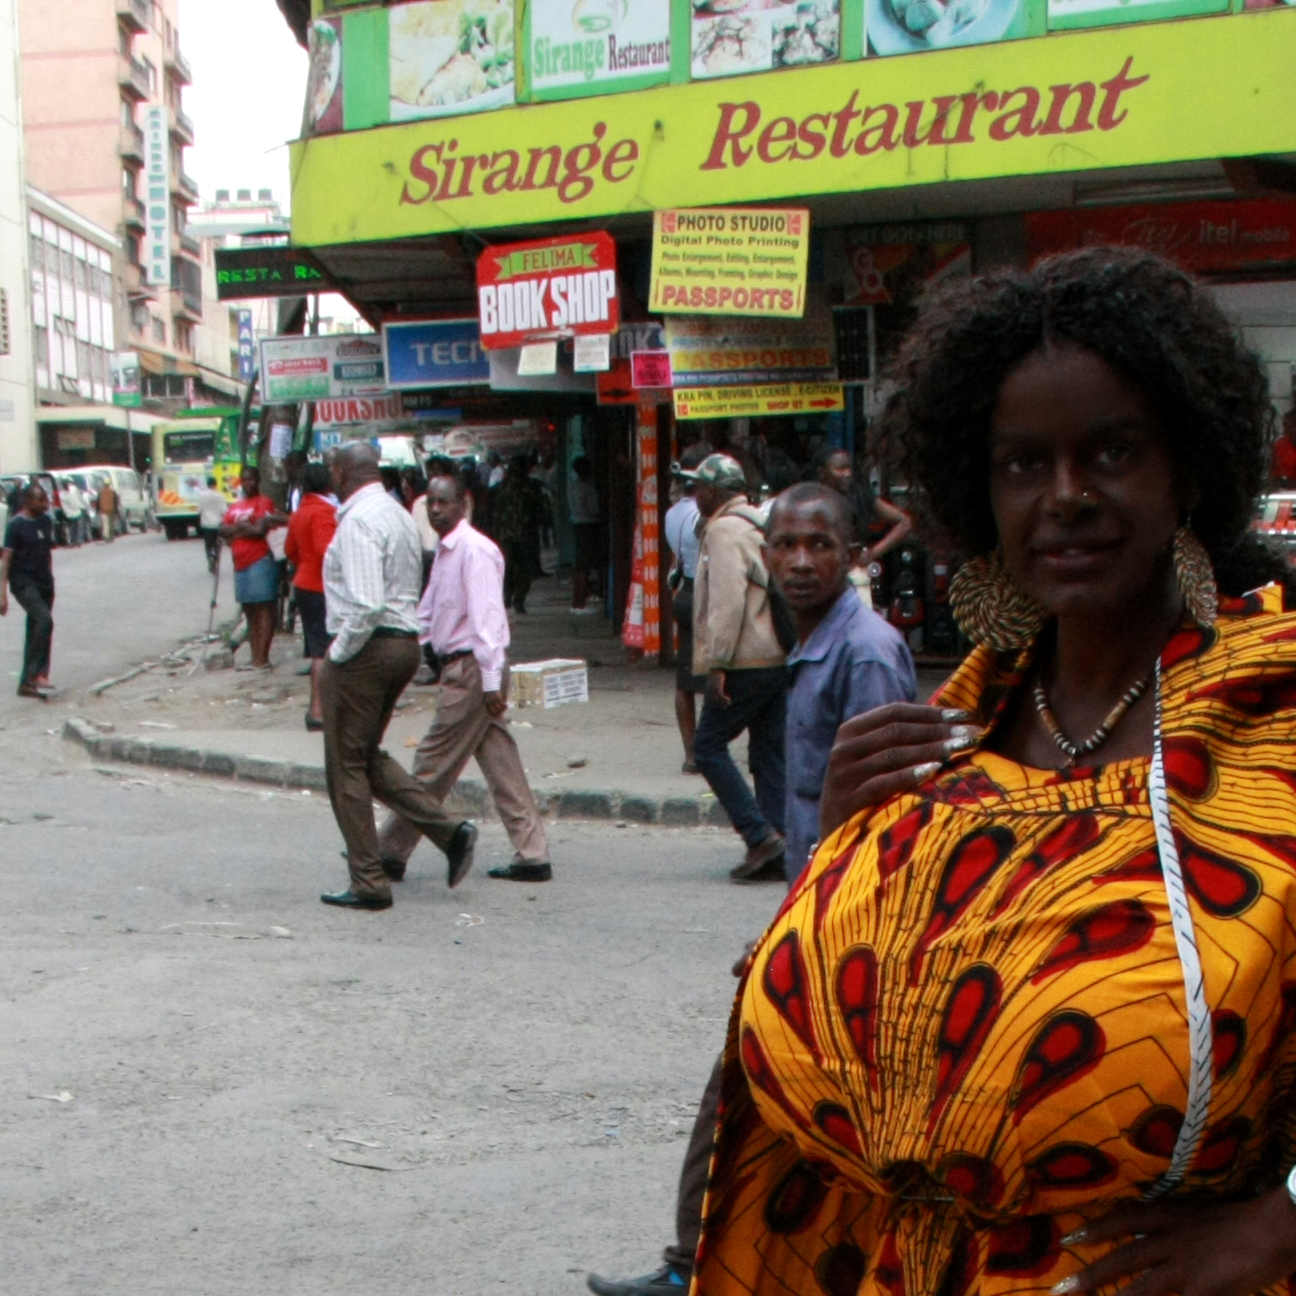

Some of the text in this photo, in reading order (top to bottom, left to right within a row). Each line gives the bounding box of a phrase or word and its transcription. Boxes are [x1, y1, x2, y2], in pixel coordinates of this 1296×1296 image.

[533, 34, 670, 80] Sirange Restaurant
[399, 55, 1150, 206] Sirange Restaurant
[677, 215, 785, 232] PHOTO STUDIO
[1199, 218, 1237, 245] itel
[661, 235, 799, 249] Digital Photo Printing
[523, 248, 576, 271] FELIMA
[480, 269, 615, 334] BOOK SHOP
[662, 285, 793, 310] PASSPORTS
[240, 311, 252, 377] PARI
[674, 349, 830, 370] PASSPORTS
